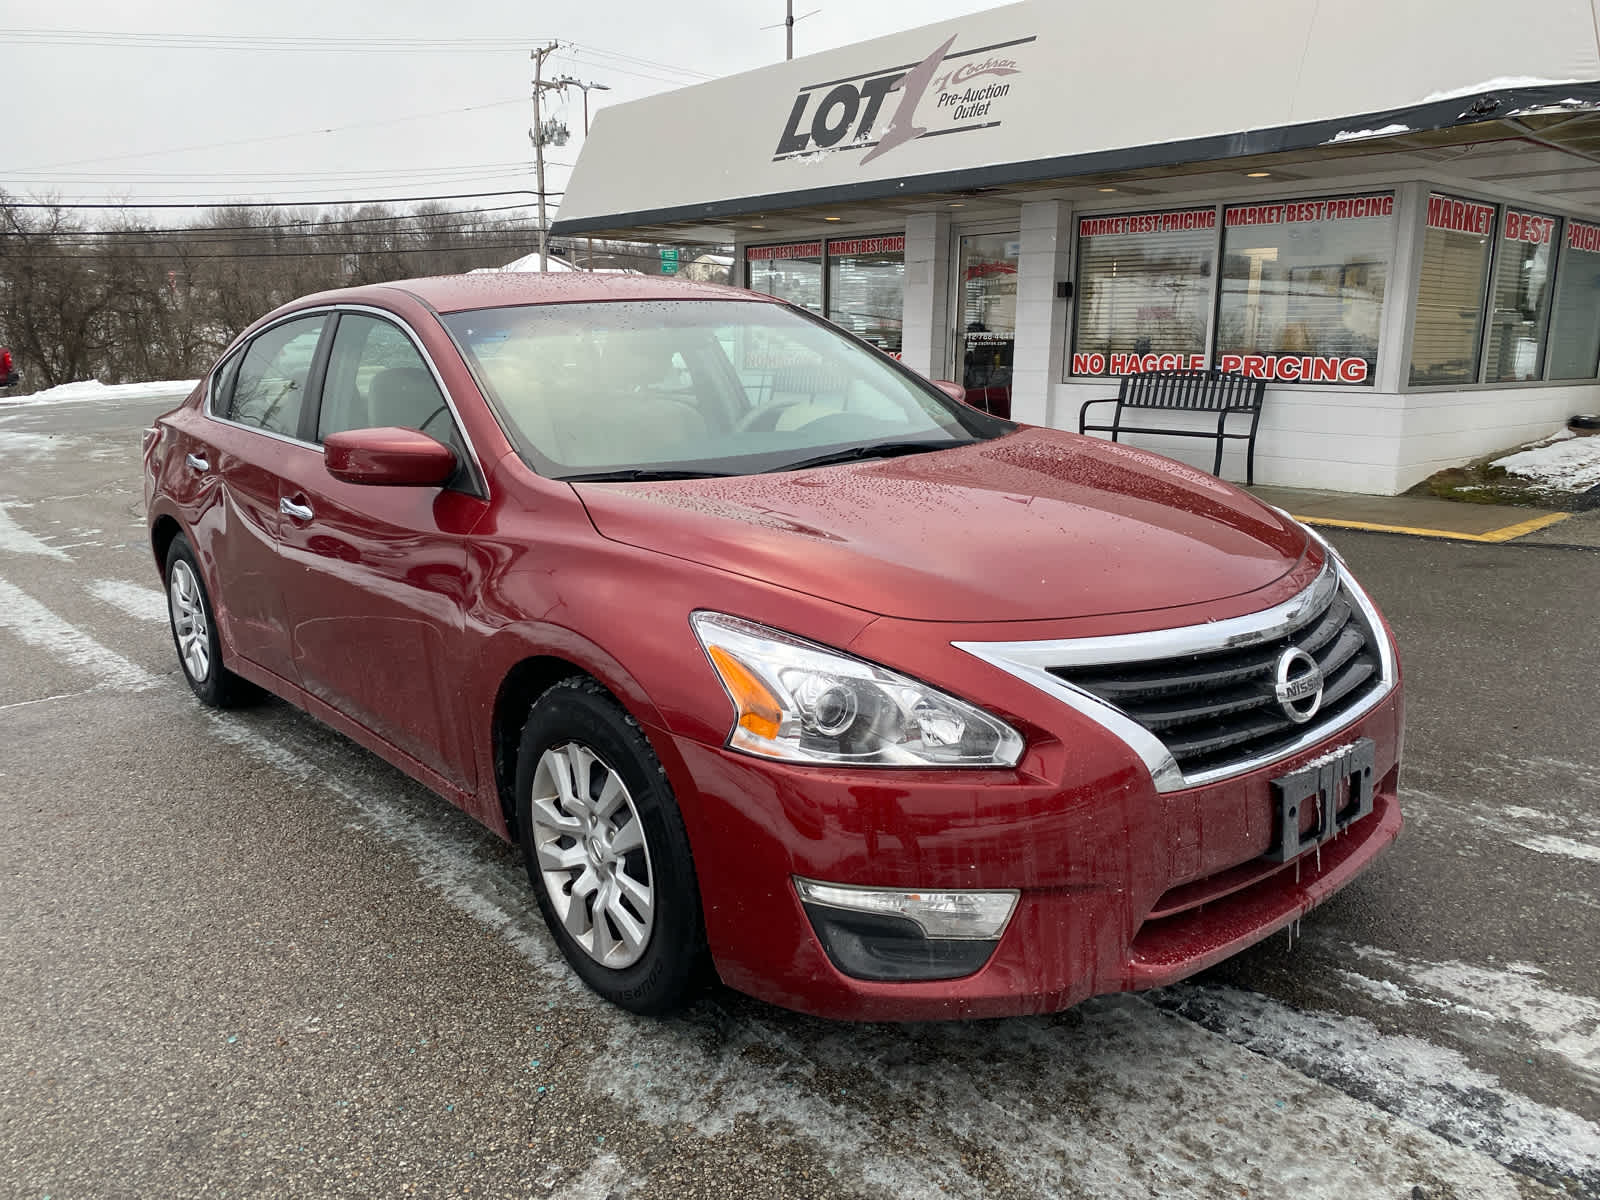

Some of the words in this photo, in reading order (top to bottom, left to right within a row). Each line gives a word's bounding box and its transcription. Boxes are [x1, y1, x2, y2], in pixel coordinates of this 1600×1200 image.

[952, 57, 1020, 84] Cochran
[775, 72, 905, 155] LOT
[860, 33, 957, 166] 1
[937, 83, 1010, 108] Pre-Auction
[953, 101, 991, 120] Outlet
[1080, 217, 1128, 237] MARKET
[1128, 214, 1161, 233] BEST
[1161, 209, 1216, 231] PRICING
[1225, 205, 1284, 227] MARKET
[1285, 202, 1325, 223] BEST
[1325, 196, 1393, 220] PRICING
[1426, 196, 1494, 236] MARKET
[1505, 211, 1554, 244] BEST
[747, 247, 774, 260] MARKET
[775, 246, 793, 259] BEST
[828, 240, 859, 256] MARKET
[860, 239, 880, 254] BEST
[1073, 353, 1104, 374] NO
[1110, 353, 1205, 376] HAGGLE
[1222, 355, 1368, 382] PRICING
